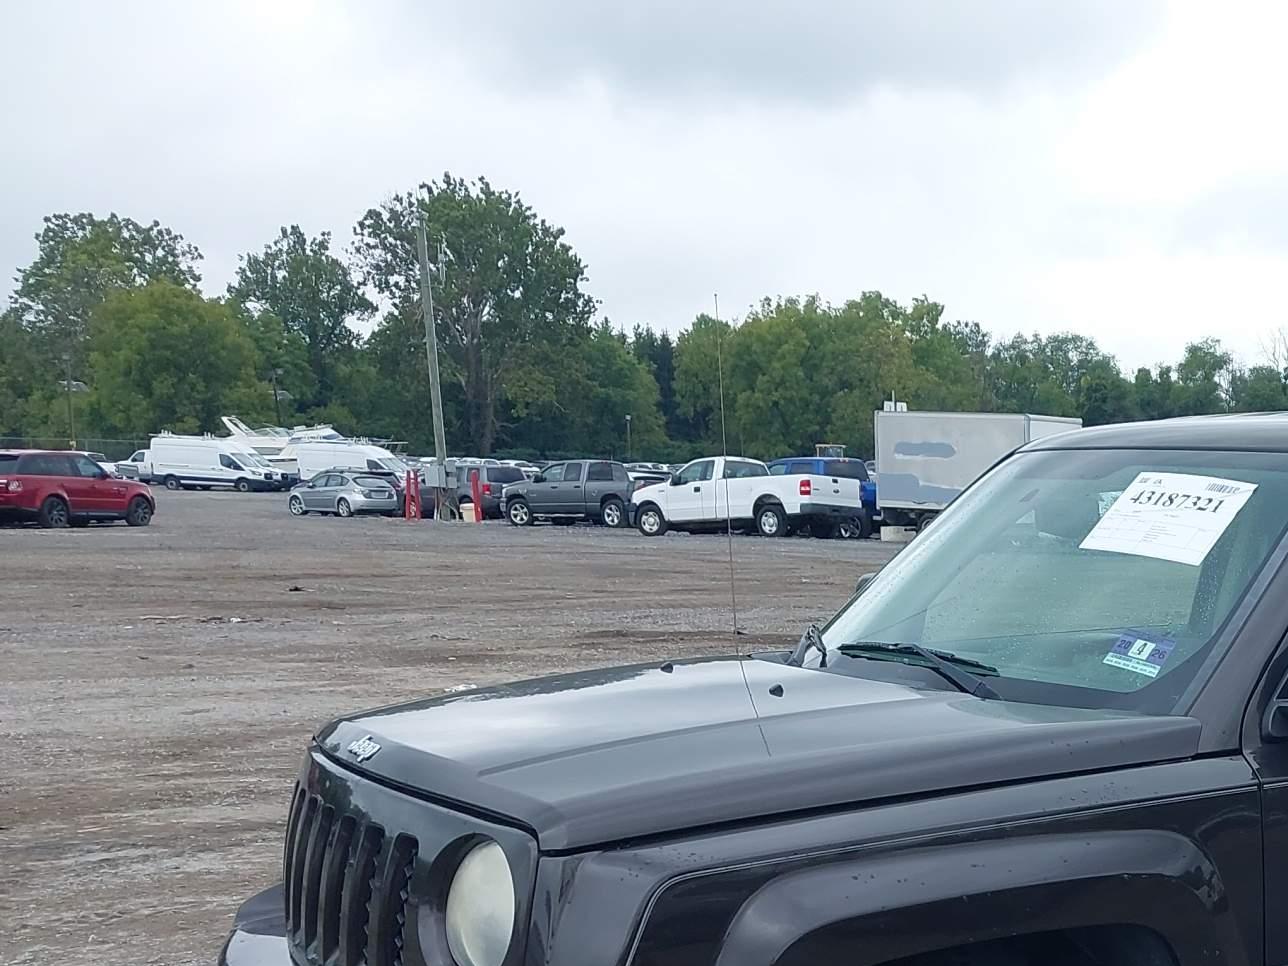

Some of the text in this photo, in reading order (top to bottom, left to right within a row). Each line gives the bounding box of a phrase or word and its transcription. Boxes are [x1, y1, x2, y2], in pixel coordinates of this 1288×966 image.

[1130, 489, 1226, 514] 43187321
[1117, 639, 1167, 660] 20 4 26
[347, 734, 382, 763] Jeep
